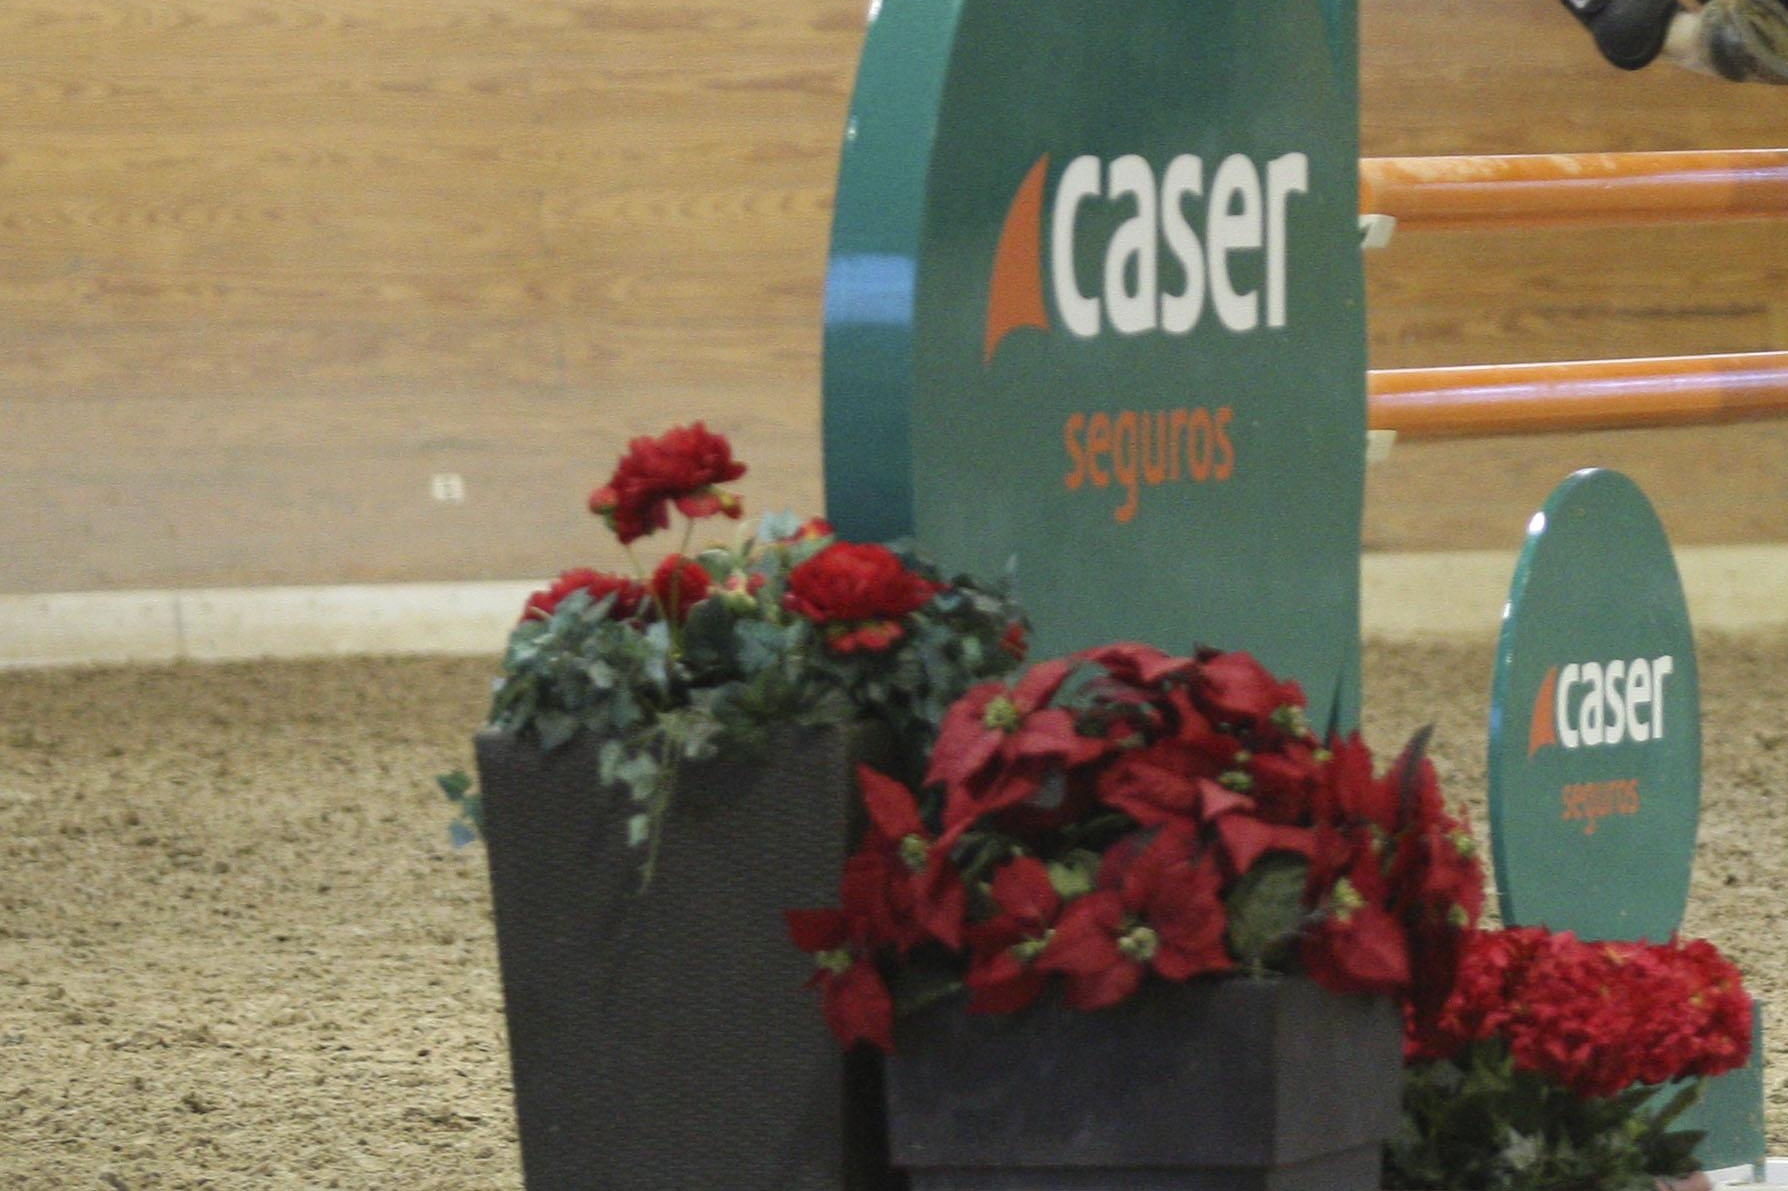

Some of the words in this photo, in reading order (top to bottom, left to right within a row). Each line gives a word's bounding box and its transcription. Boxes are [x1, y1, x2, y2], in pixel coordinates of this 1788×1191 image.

[1052, 152, 1309, 338] caser
[1063, 405, 1235, 523] seguros
[1556, 654, 1674, 748] caser
[1560, 777, 1641, 836] seguros
